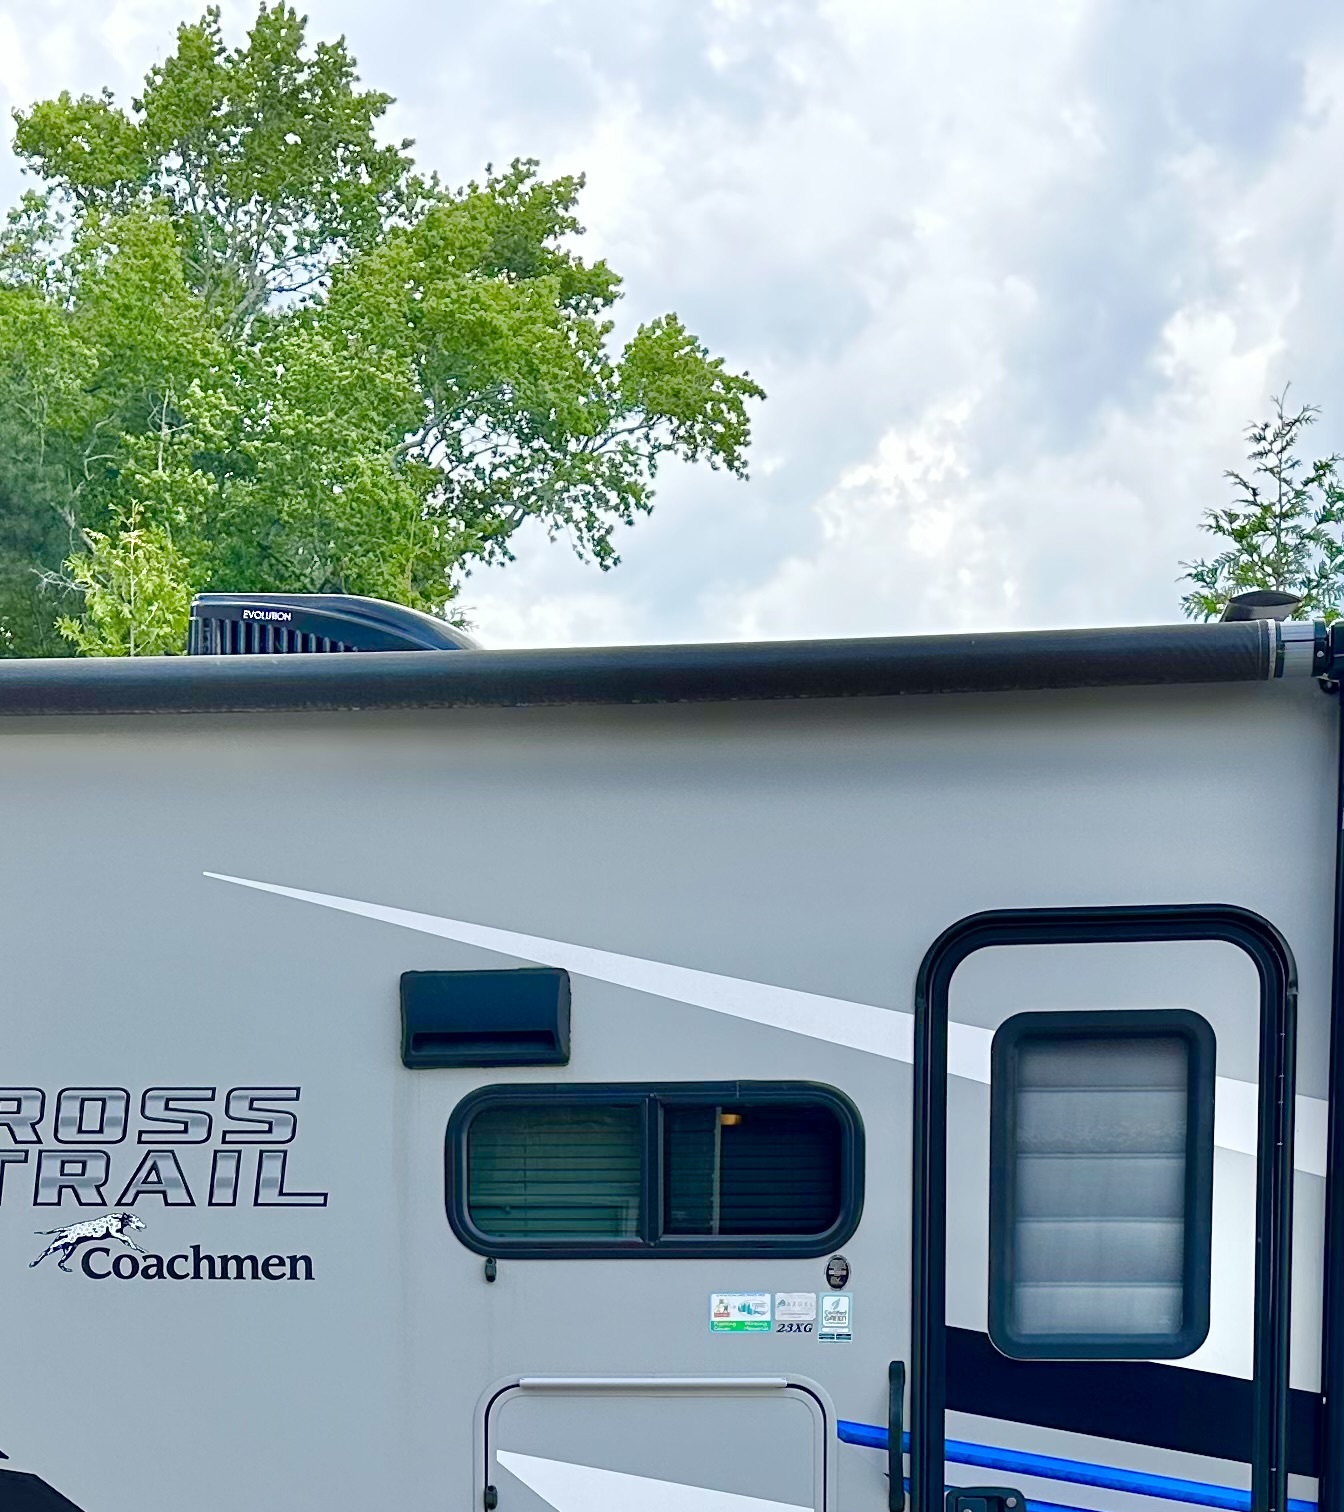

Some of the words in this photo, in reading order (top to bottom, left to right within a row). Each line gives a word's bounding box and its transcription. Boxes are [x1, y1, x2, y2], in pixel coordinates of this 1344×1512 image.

[242, 609, 292, 621] EVOLUTION
[80, 1244, 316, 1281] Coachmen
[776, 1322, 814, 1333] 23XG
